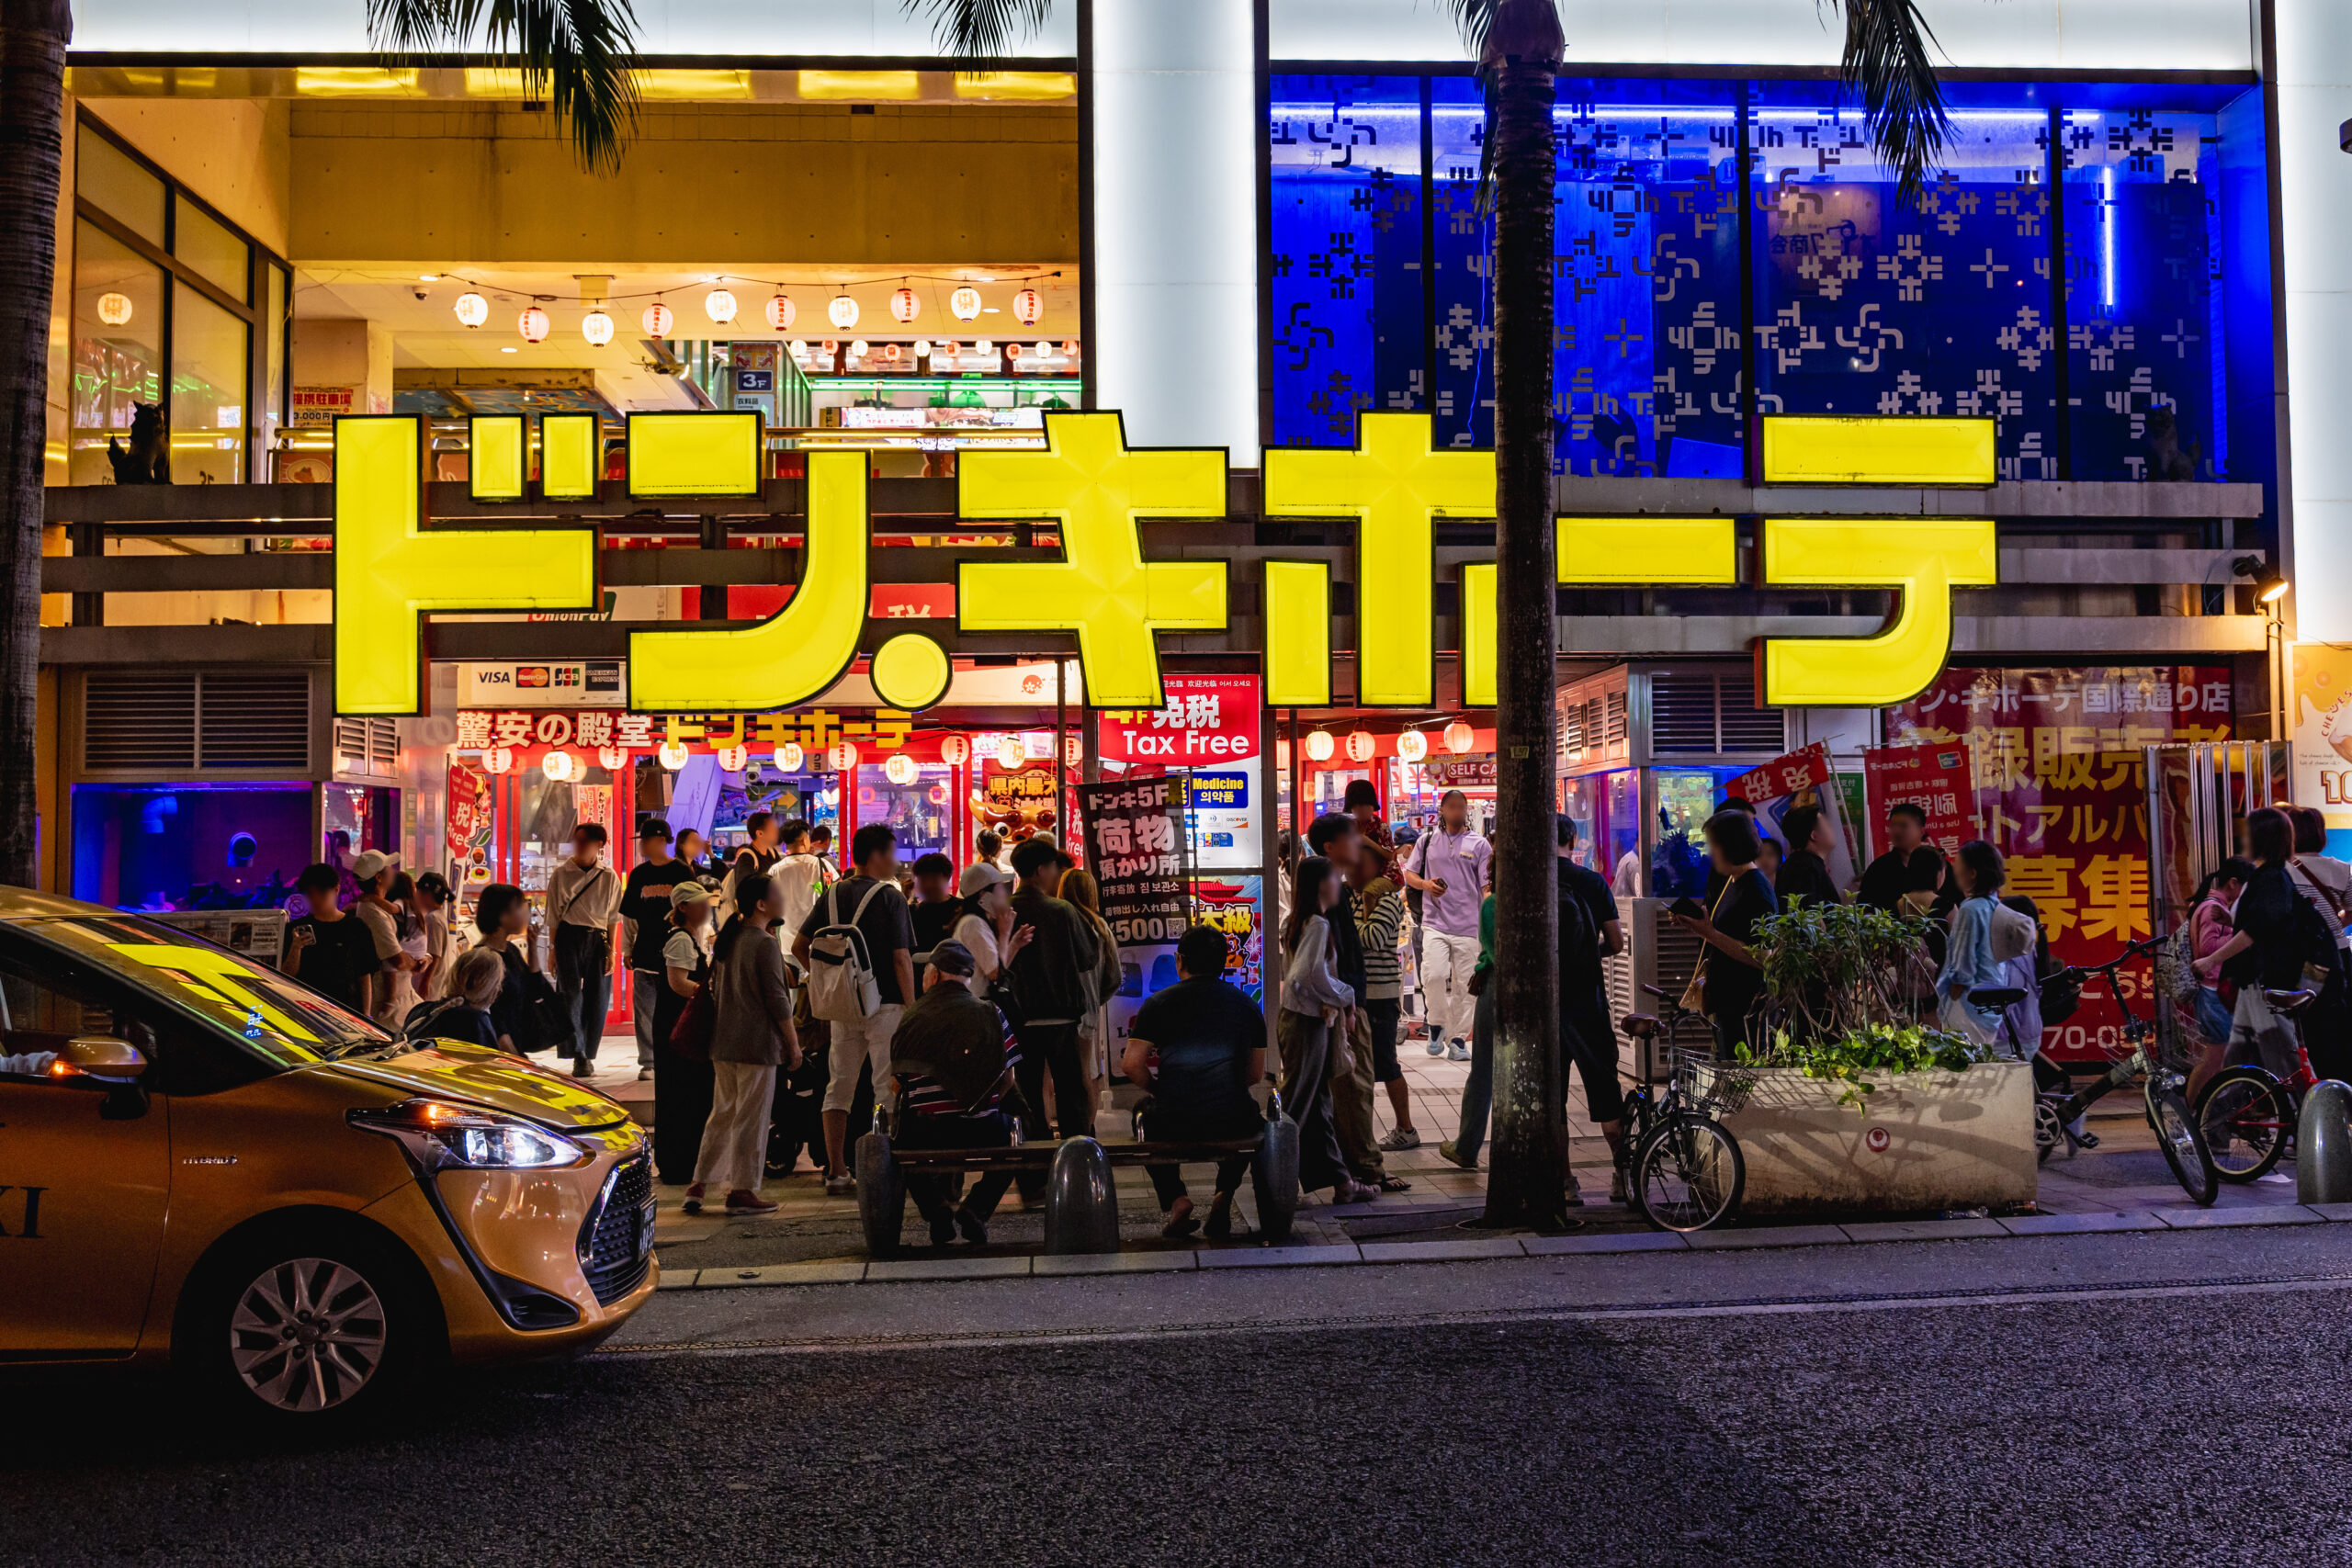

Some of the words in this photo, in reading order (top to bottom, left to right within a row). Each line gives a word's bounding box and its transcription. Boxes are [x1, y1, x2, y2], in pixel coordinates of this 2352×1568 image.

[742, 373, 767, 389] 3F
[478, 672, 511, 683] VISA
[1187, 680, 1217, 688] 欢迎光临
[1152, 694, 1221, 728] 免税
[458, 712, 653, 749] 驚安の殿堂
[1123, 730, 1176, 755] Tax
[1186, 730, 1250, 755] Free
[1450, 763, 1476, 775] SELF
[1193, 778, 1244, 789] Medicine
[1089, 784, 1170, 810] ドンキ5F
[1200, 791, 1234, 803] 의약품
[1415, 818, 1423, 827] 1
[1428, 815, 1436, 824] 2
[1092, 814, 1175, 855] 荷物
[1099, 853, 1181, 881] 預かり所
[1140, 882, 1149, 895] 짐
[1152, 882, 1180, 893] 보관소
[1998, 854, 2151, 942] 募集
[1105, 902, 1180, 918] 荷物出し入れ自由
[1191, 904, 1253, 933] 大級
